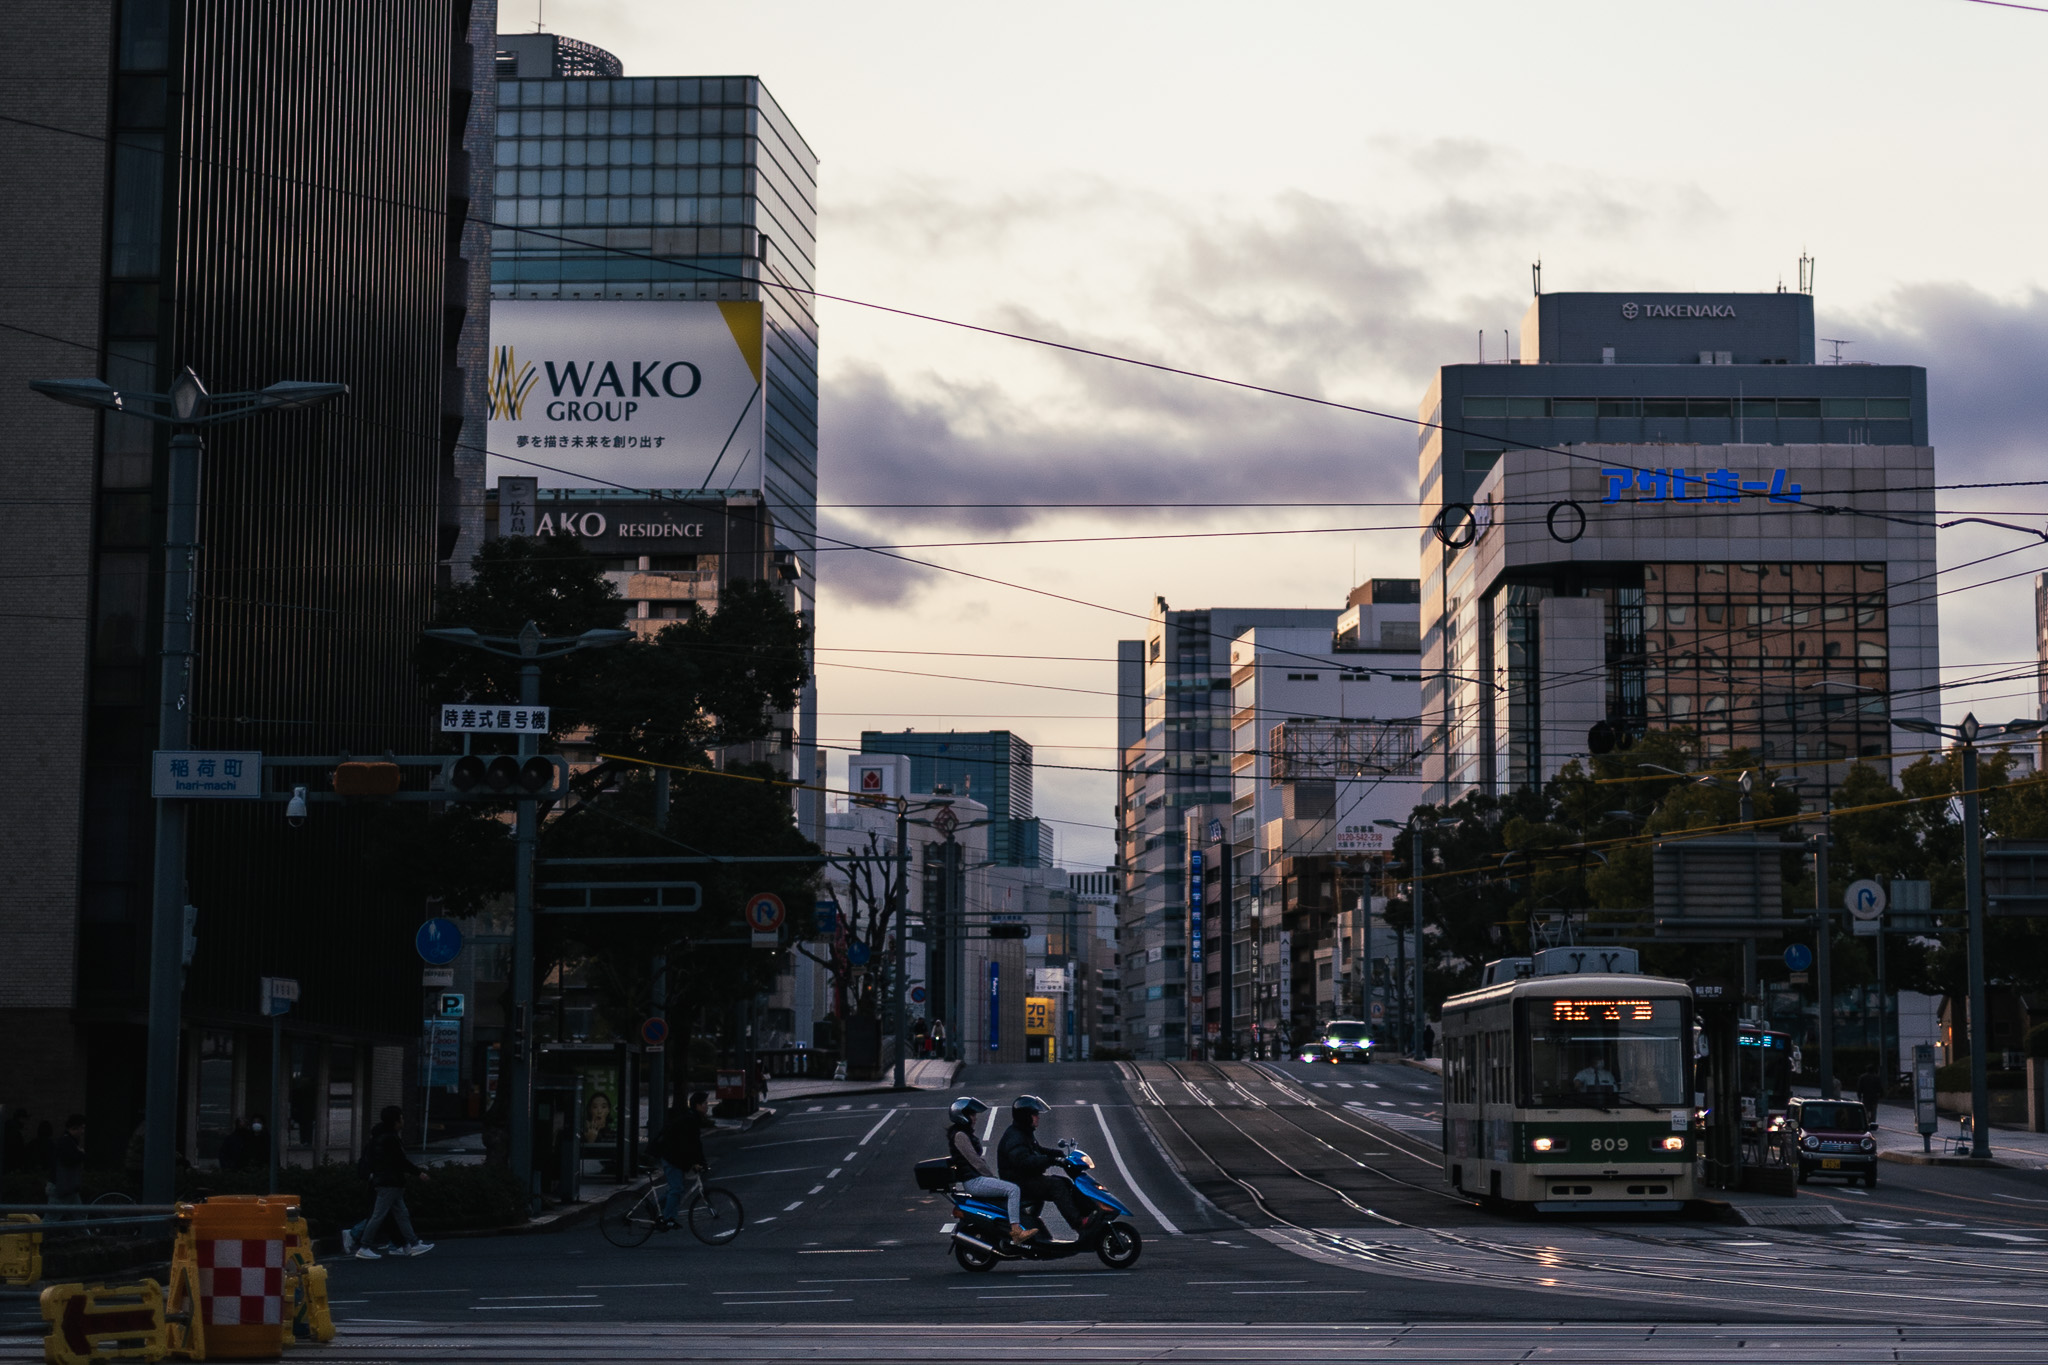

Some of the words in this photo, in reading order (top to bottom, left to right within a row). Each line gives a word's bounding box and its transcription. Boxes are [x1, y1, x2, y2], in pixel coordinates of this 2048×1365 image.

[1643, 304, 1736, 317] TAKENAKA
[544, 361, 702, 398] WAKO
[546, 401, 638, 421] GROUP
[516, 435, 665, 448] 夢を描き未来を創り出す
[1601, 468, 1802, 505] アサヒホーム
[536, 512, 607, 537] AKO
[619, 523, 704, 537] RESIDENCE
[444, 709, 546, 729] 時差式信号機
[170, 759, 243, 777] 稲荷町
[176, 780, 236, 790] Inari-machi
[1337, 833, 1383, 841] 0120-542-238
[443, 996, 460, 1013] P
[1027, 1004, 1045, 1015] プロ
[1027, 1017, 1045, 1028] ミス
[1590, 1138, 1629, 1151] 809
